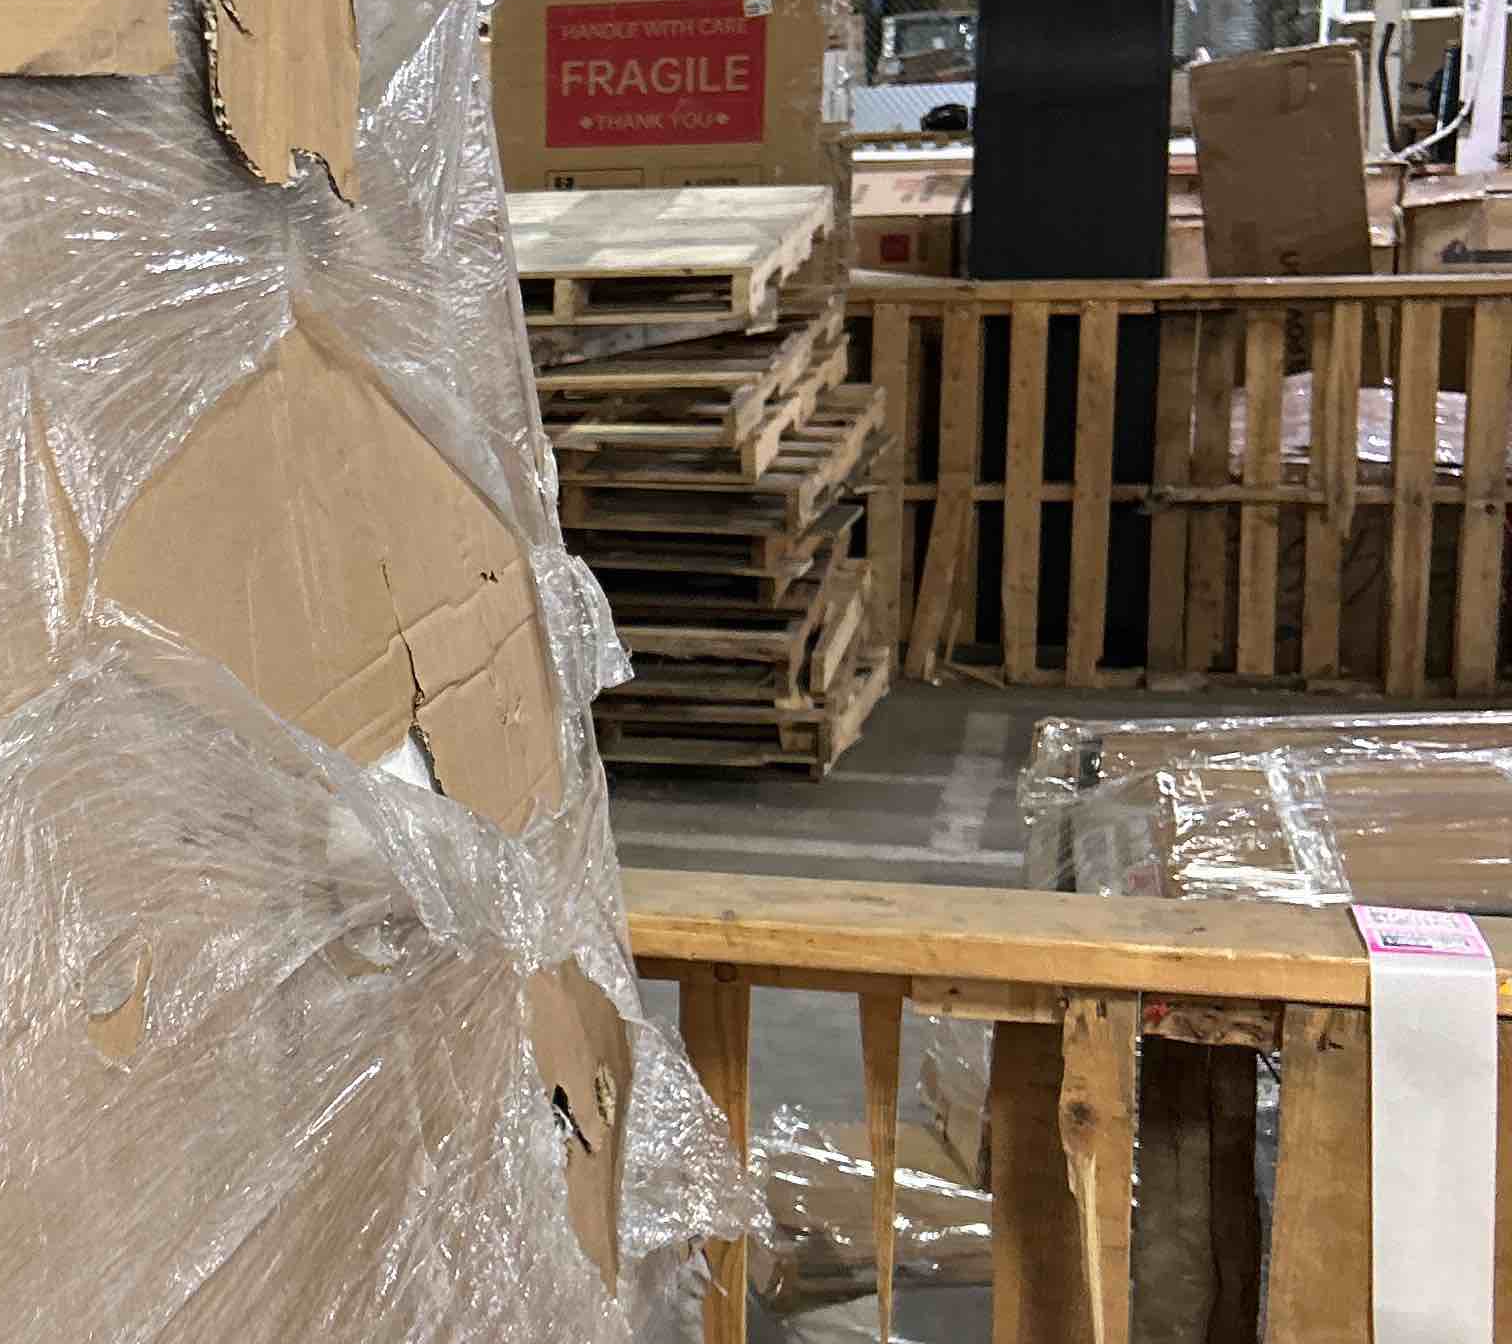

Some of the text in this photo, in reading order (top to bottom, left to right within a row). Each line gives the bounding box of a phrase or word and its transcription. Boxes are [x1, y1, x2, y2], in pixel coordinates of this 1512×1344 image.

[560, 15, 748, 41] HANDLE WITH CARE
[561, 55, 749, 96] FRAGILE
[597, 108, 715, 131] THANK YOU
